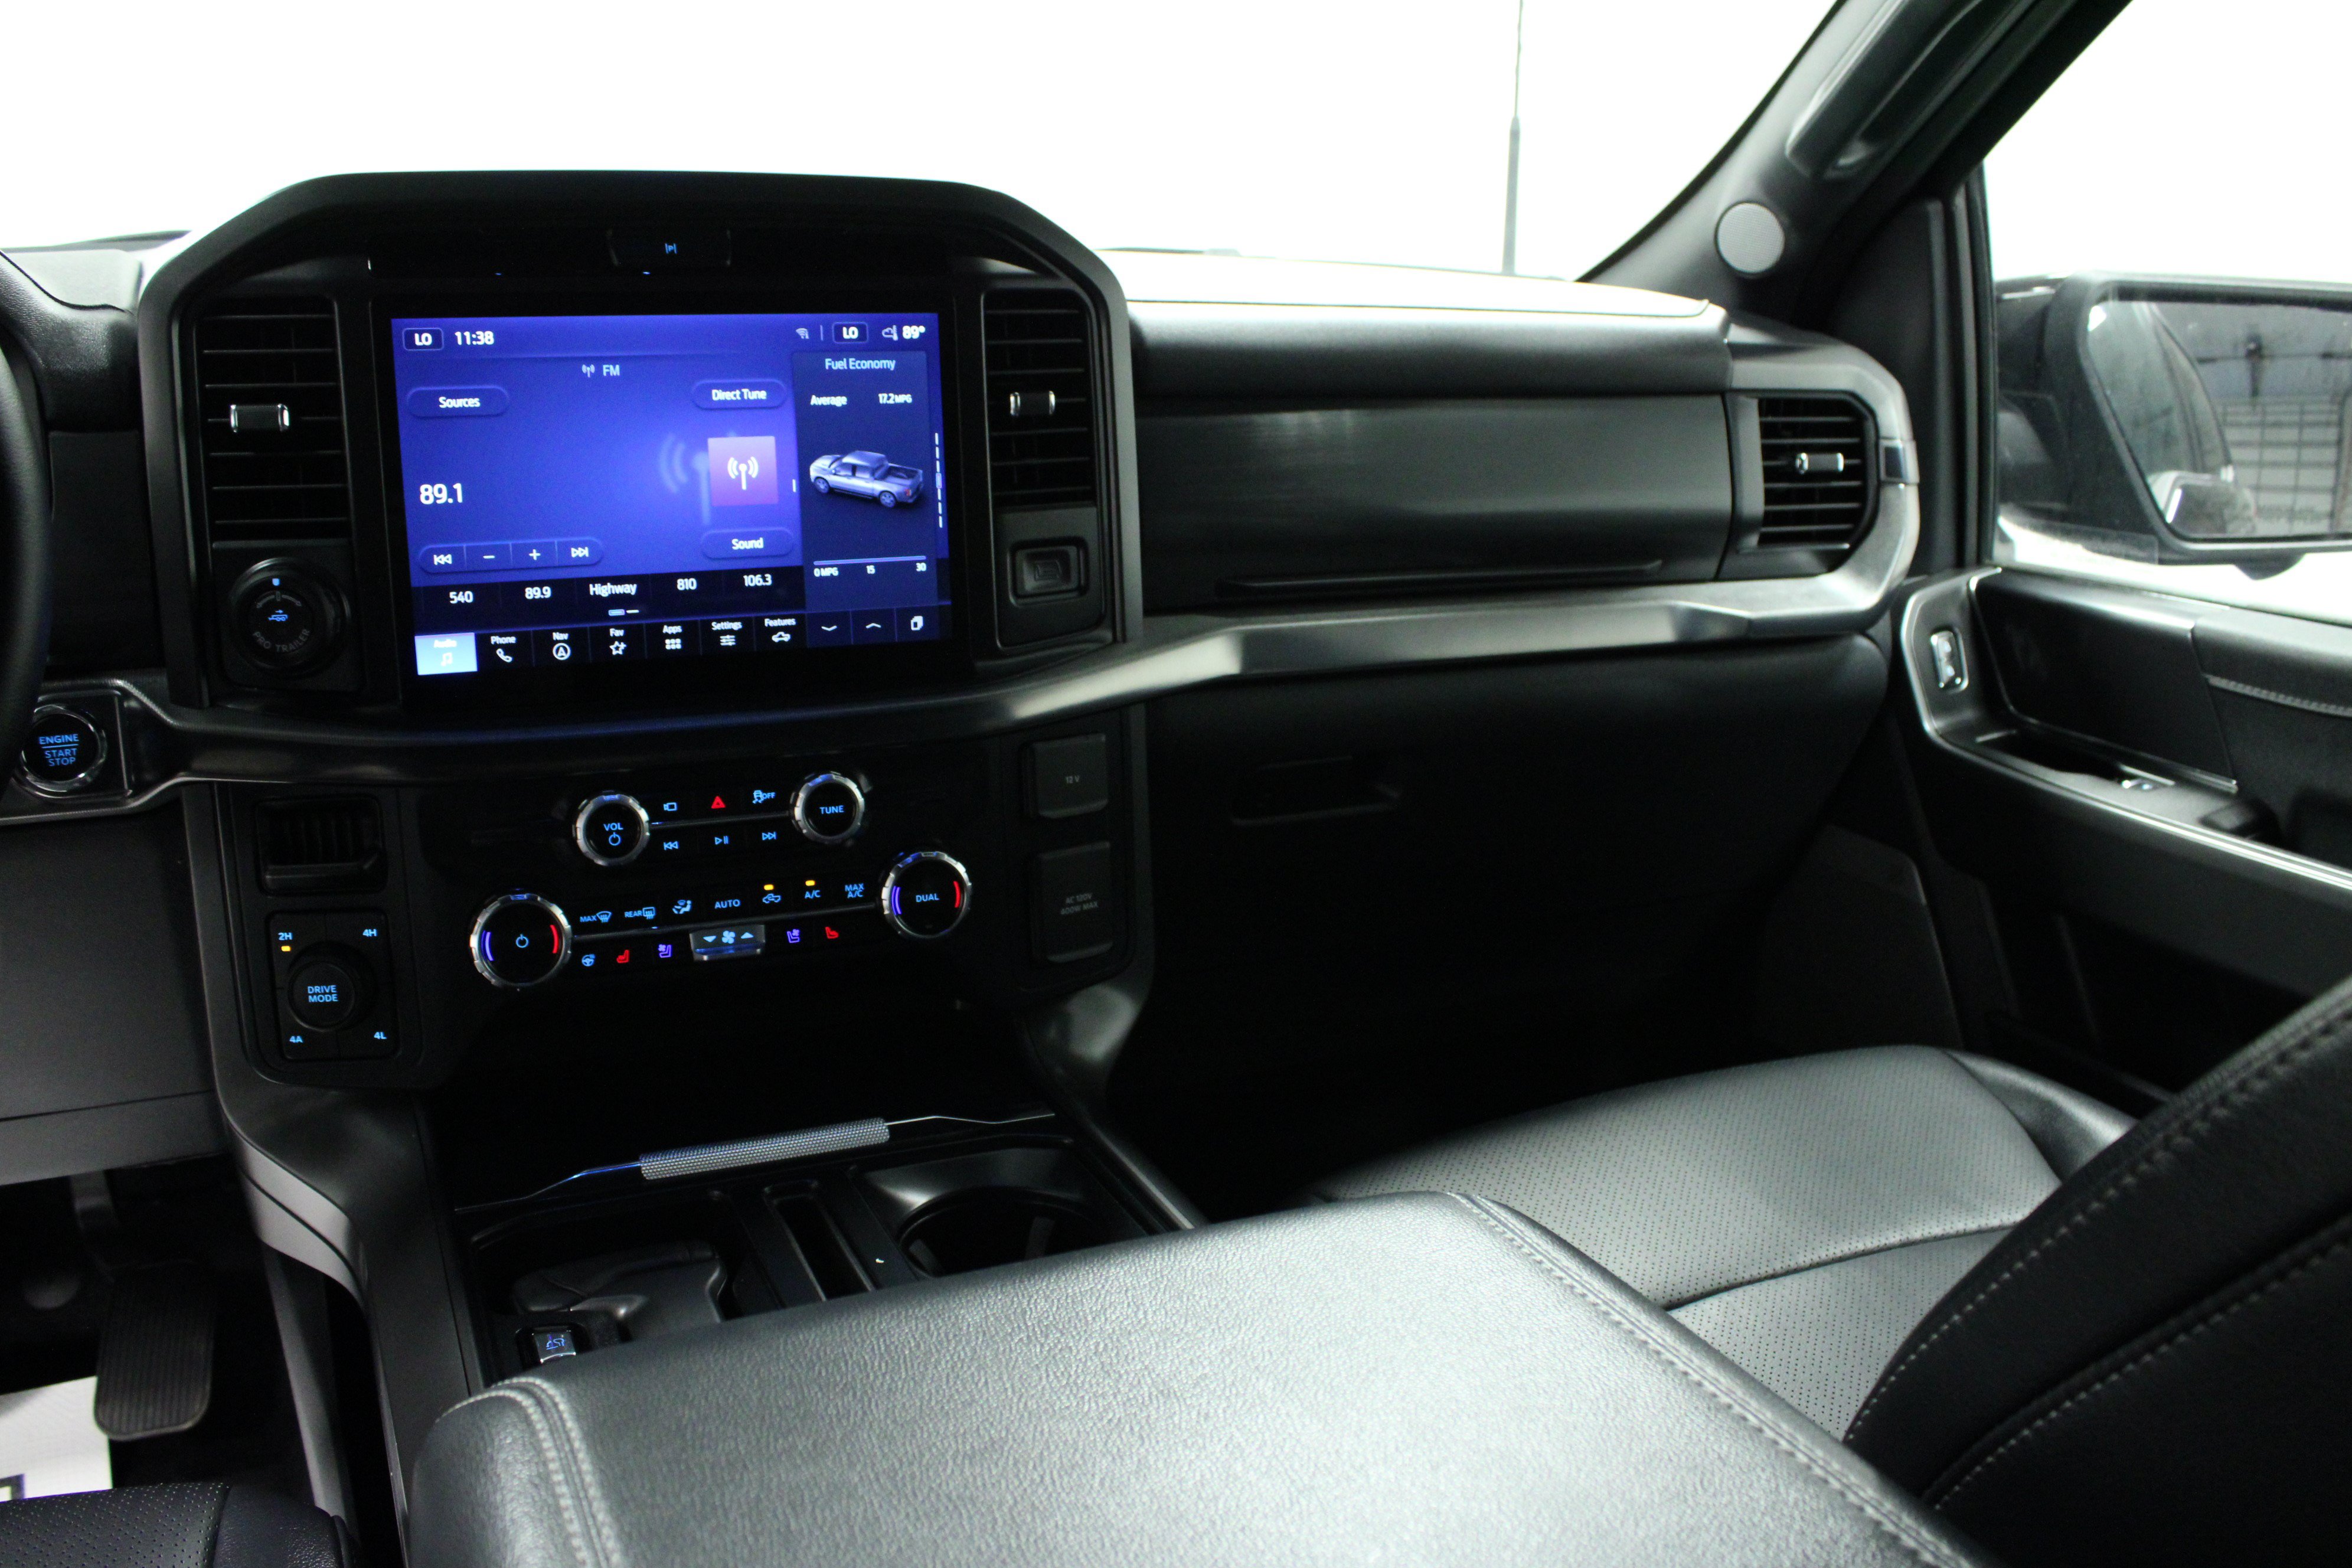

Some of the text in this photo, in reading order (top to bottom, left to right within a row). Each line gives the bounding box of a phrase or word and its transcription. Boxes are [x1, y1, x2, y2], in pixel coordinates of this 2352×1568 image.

[843, 326, 858, 339] LO
[415, 333, 432, 345] LO
[455, 331, 494, 345] 11:38
[825, 358, 896, 370] Fuel Economy
[603, 365, 620, 376] FM
[712, 388, 767, 400] Direct Tune
[439, 397, 481, 408] Sources
[811, 395, 847, 407] Average
[420, 483, 462, 504] 89.1
[732, 537, 763, 550] Sound
[867, 565, 875, 574] 15
[916, 563, 926, 571] 30
[677, 578, 697, 590] 810
[743, 574, 772, 586] 106.3
[525, 586, 551, 599] 89.9
[589, 583, 637, 597] Highway
[450, 591, 473, 603] 540
[663, 625, 682, 634] Apps
[712, 622, 742, 631] Settings
[610, 628, 624, 636] Fav
[491, 636, 516, 644] Phone
[38, 734, 79, 744] ENGINE
[44, 748, 77, 758] START
[49, 757, 76, 766] STOP
[820, 805, 844, 814] TUNE
[845, 883, 864, 891] MAX
[805, 890, 821, 899] A/C
[847, 890, 864, 899] A/C
[916, 893, 939, 902] DUAL
[715, 899, 741, 909] AUTO
[308, 985, 337, 994] DRIVE
[309, 994, 338, 1002] MODE
